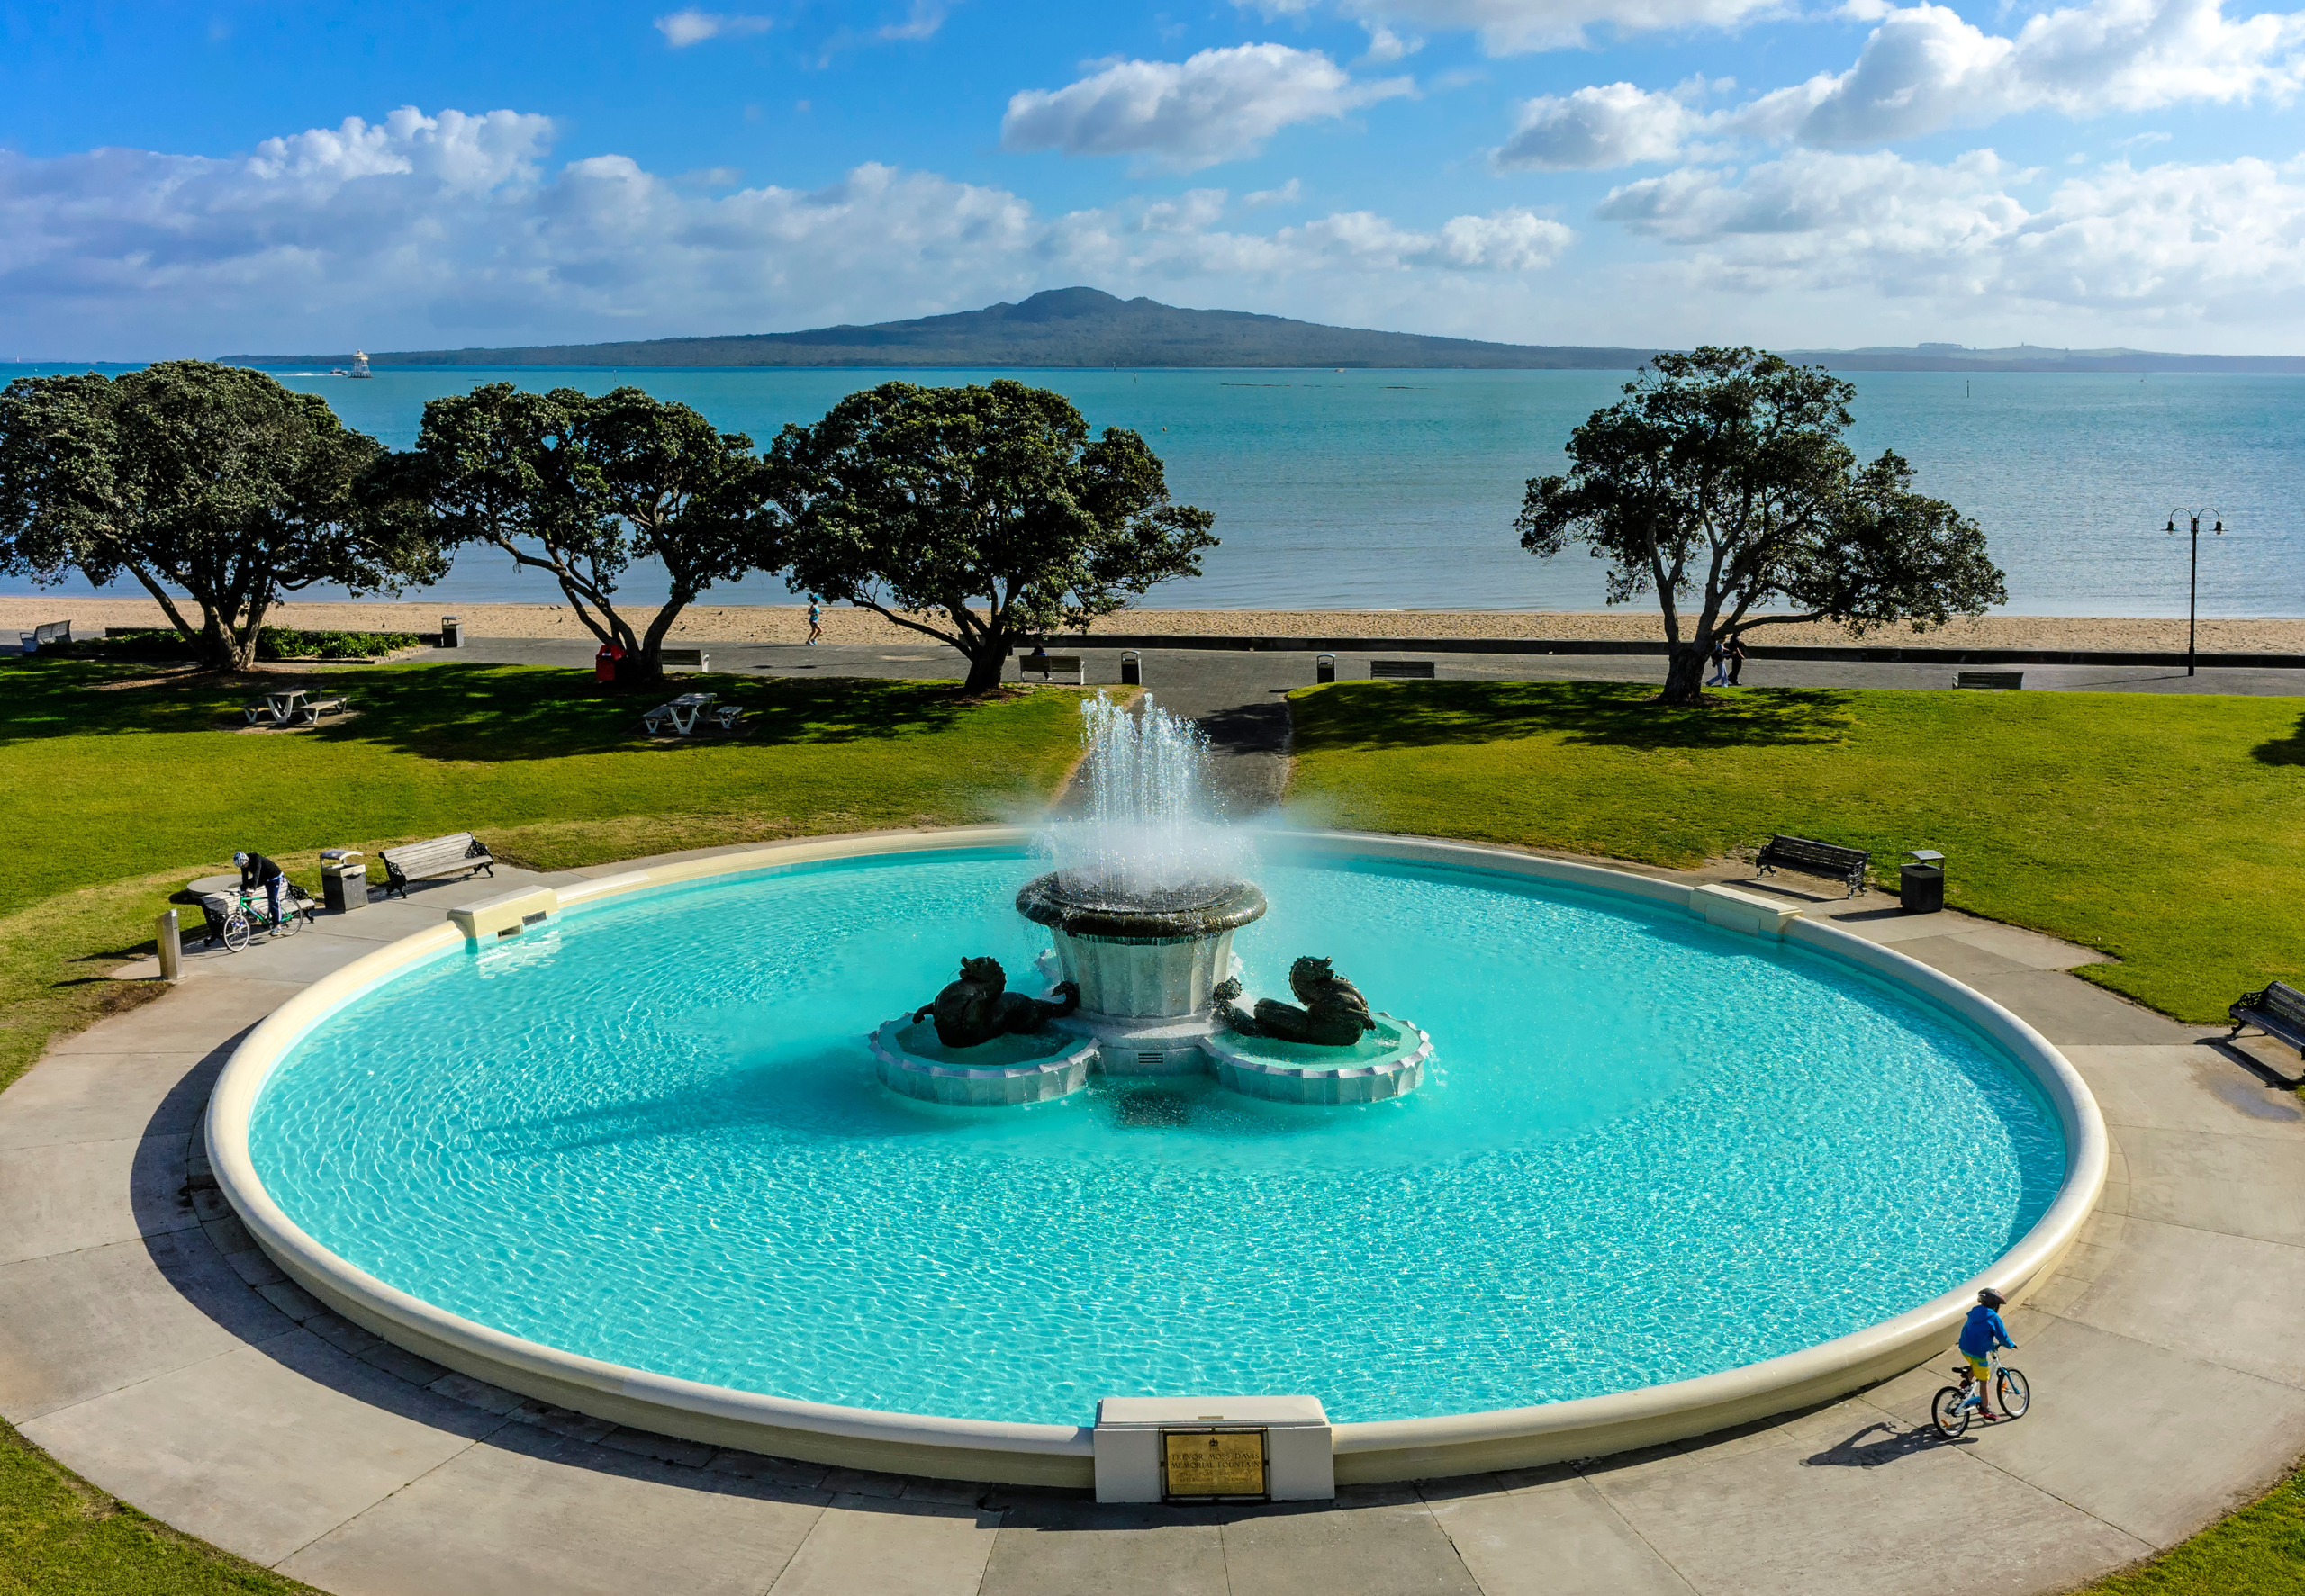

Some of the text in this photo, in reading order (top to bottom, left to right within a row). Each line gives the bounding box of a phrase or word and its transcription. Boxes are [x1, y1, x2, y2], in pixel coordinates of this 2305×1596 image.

[1234, 1452, 1260, 1460] DAVIS
[1171, 1460, 1260, 1469] MEMORIAL FOUNTAIN
